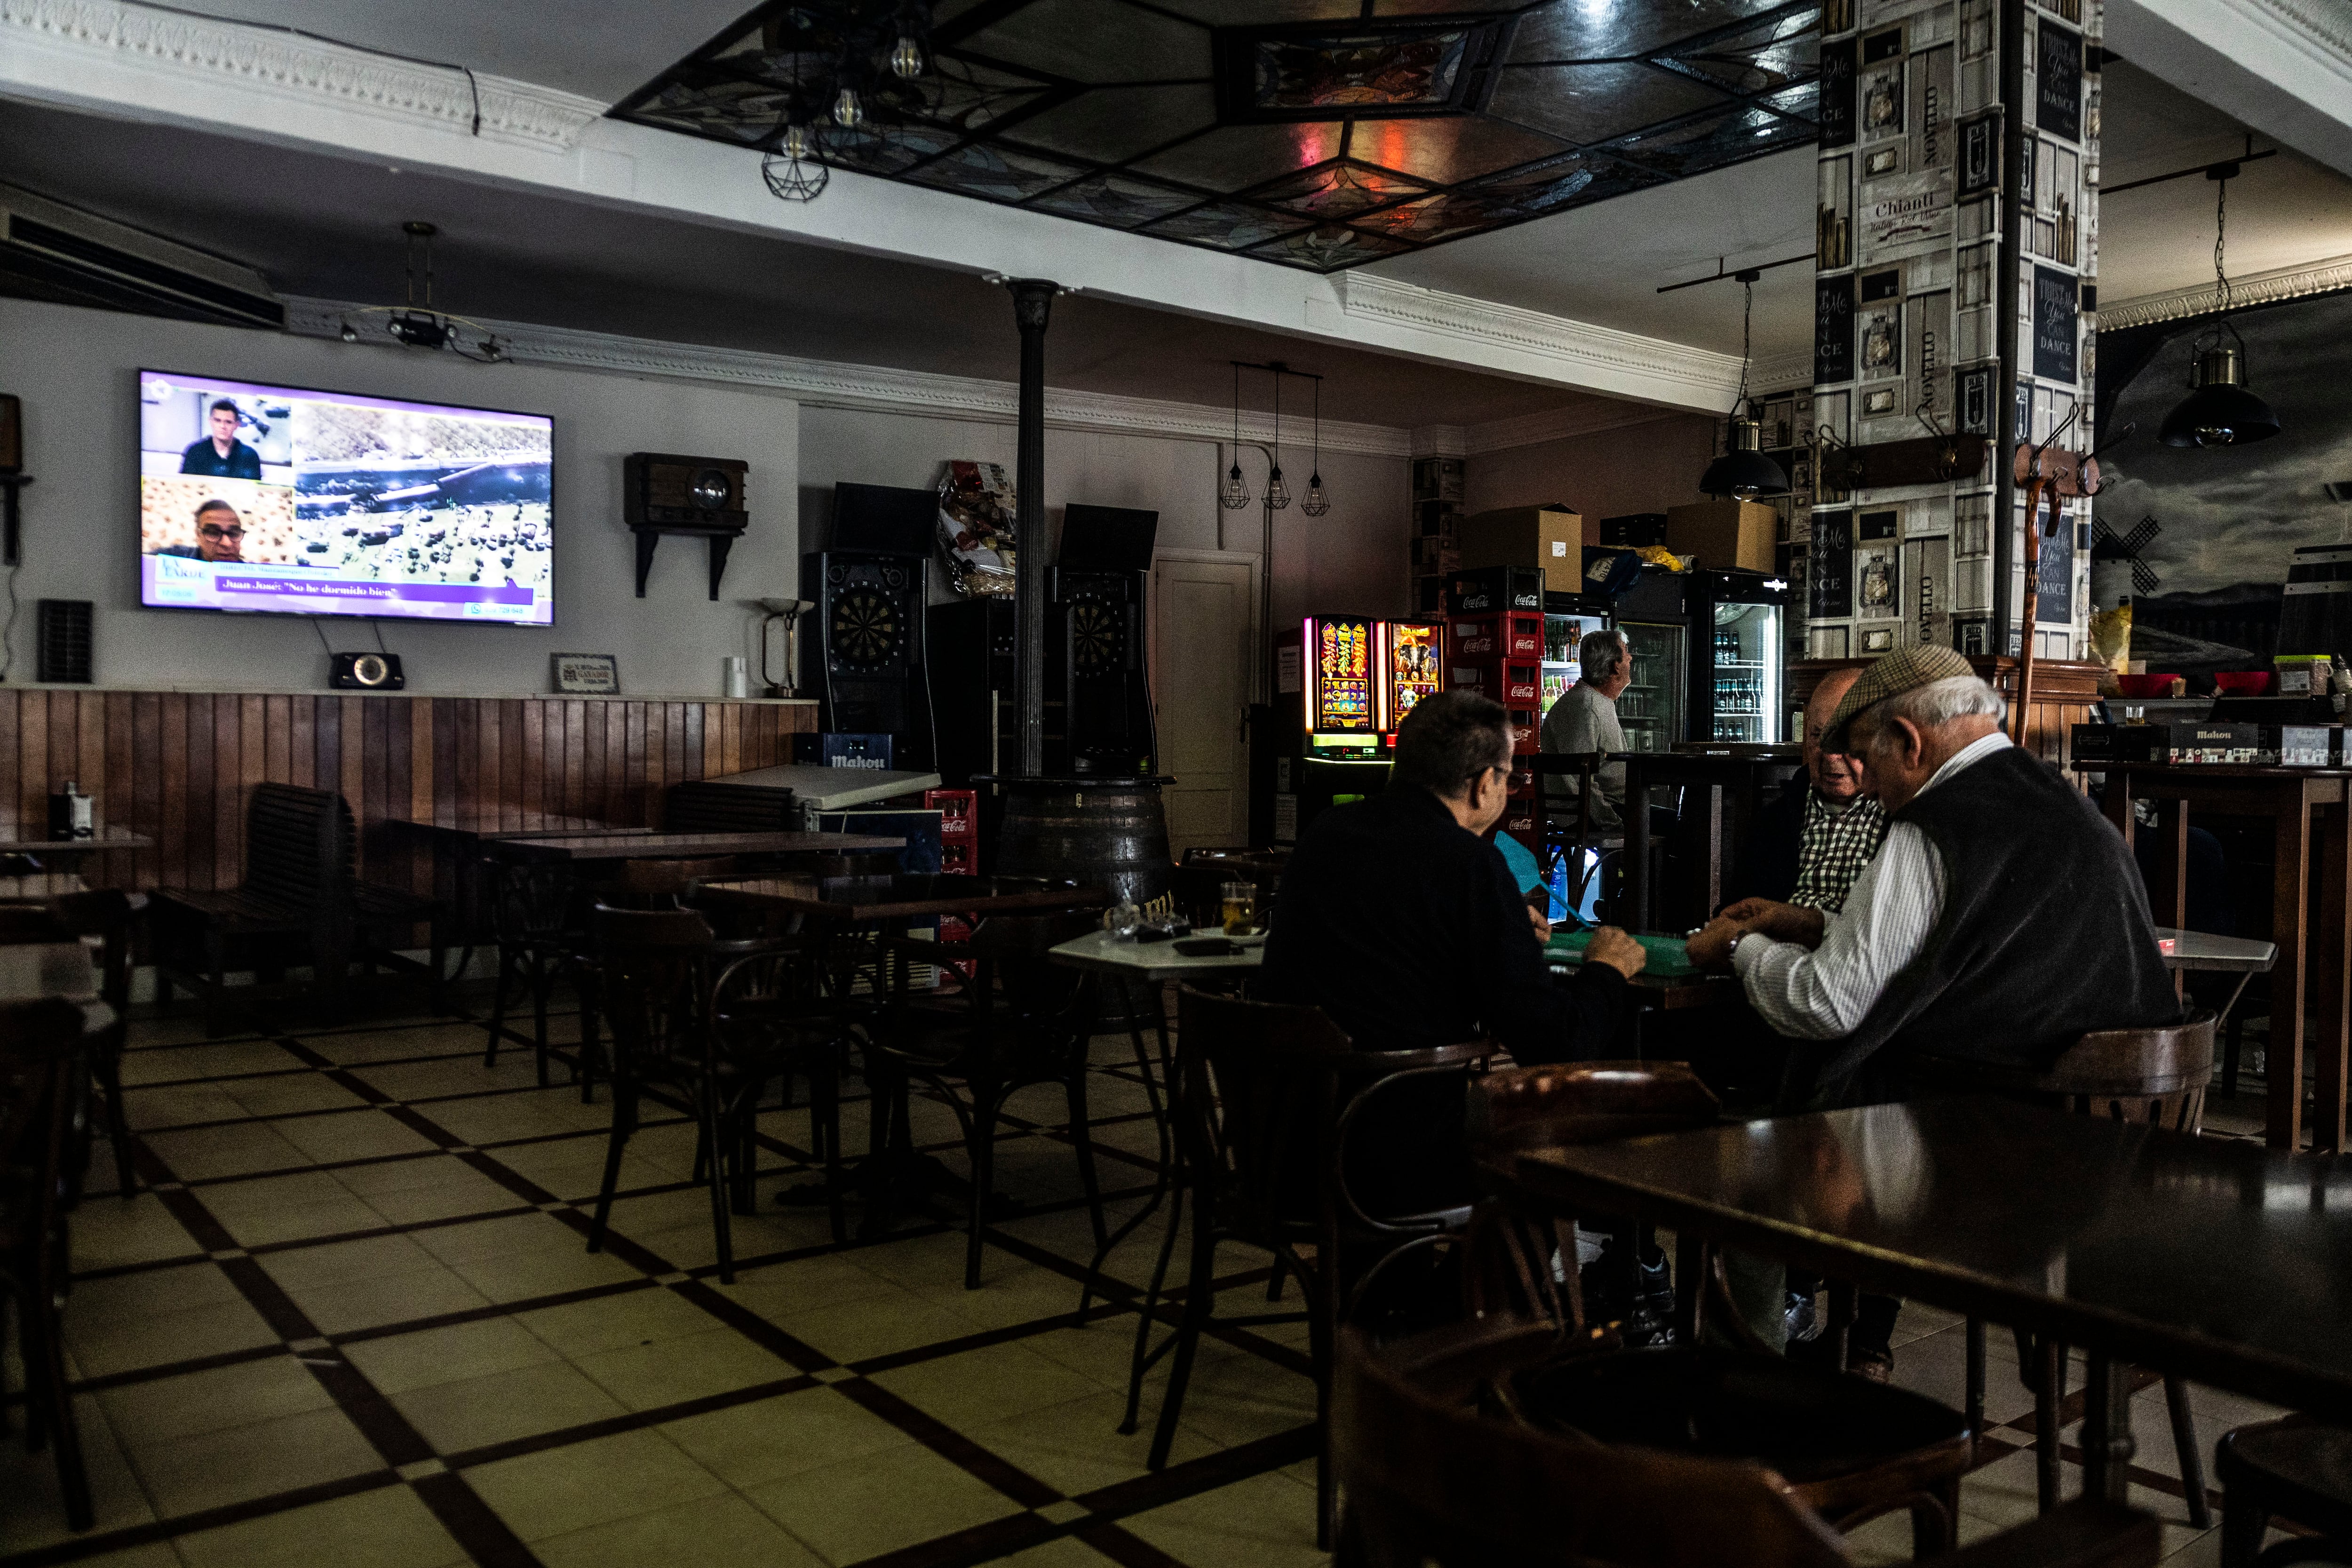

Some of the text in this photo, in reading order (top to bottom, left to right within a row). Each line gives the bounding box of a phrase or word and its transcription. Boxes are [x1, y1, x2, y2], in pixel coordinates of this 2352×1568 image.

[2043, 88, 2075, 114] DANCE
[1924, 86, 1938, 165] NOVELLO
[1876, 191, 1933, 217] Chianti
[2040, 335, 2071, 355] DANCE
[1922, 332, 1935, 409] NOVELLO
[222, 579, 250, 589] Juan
[306, 583, 318, 592] he
[321, 584, 366, 595] dormido
[1811, 577, 1840, 591] NCE
[1920, 576, 1933, 643] OVELLO
[2197, 731, 2232, 740] Mahou
[831, 755, 885, 769] Mahou
[942, 820, 966, 832] ca-Cola
